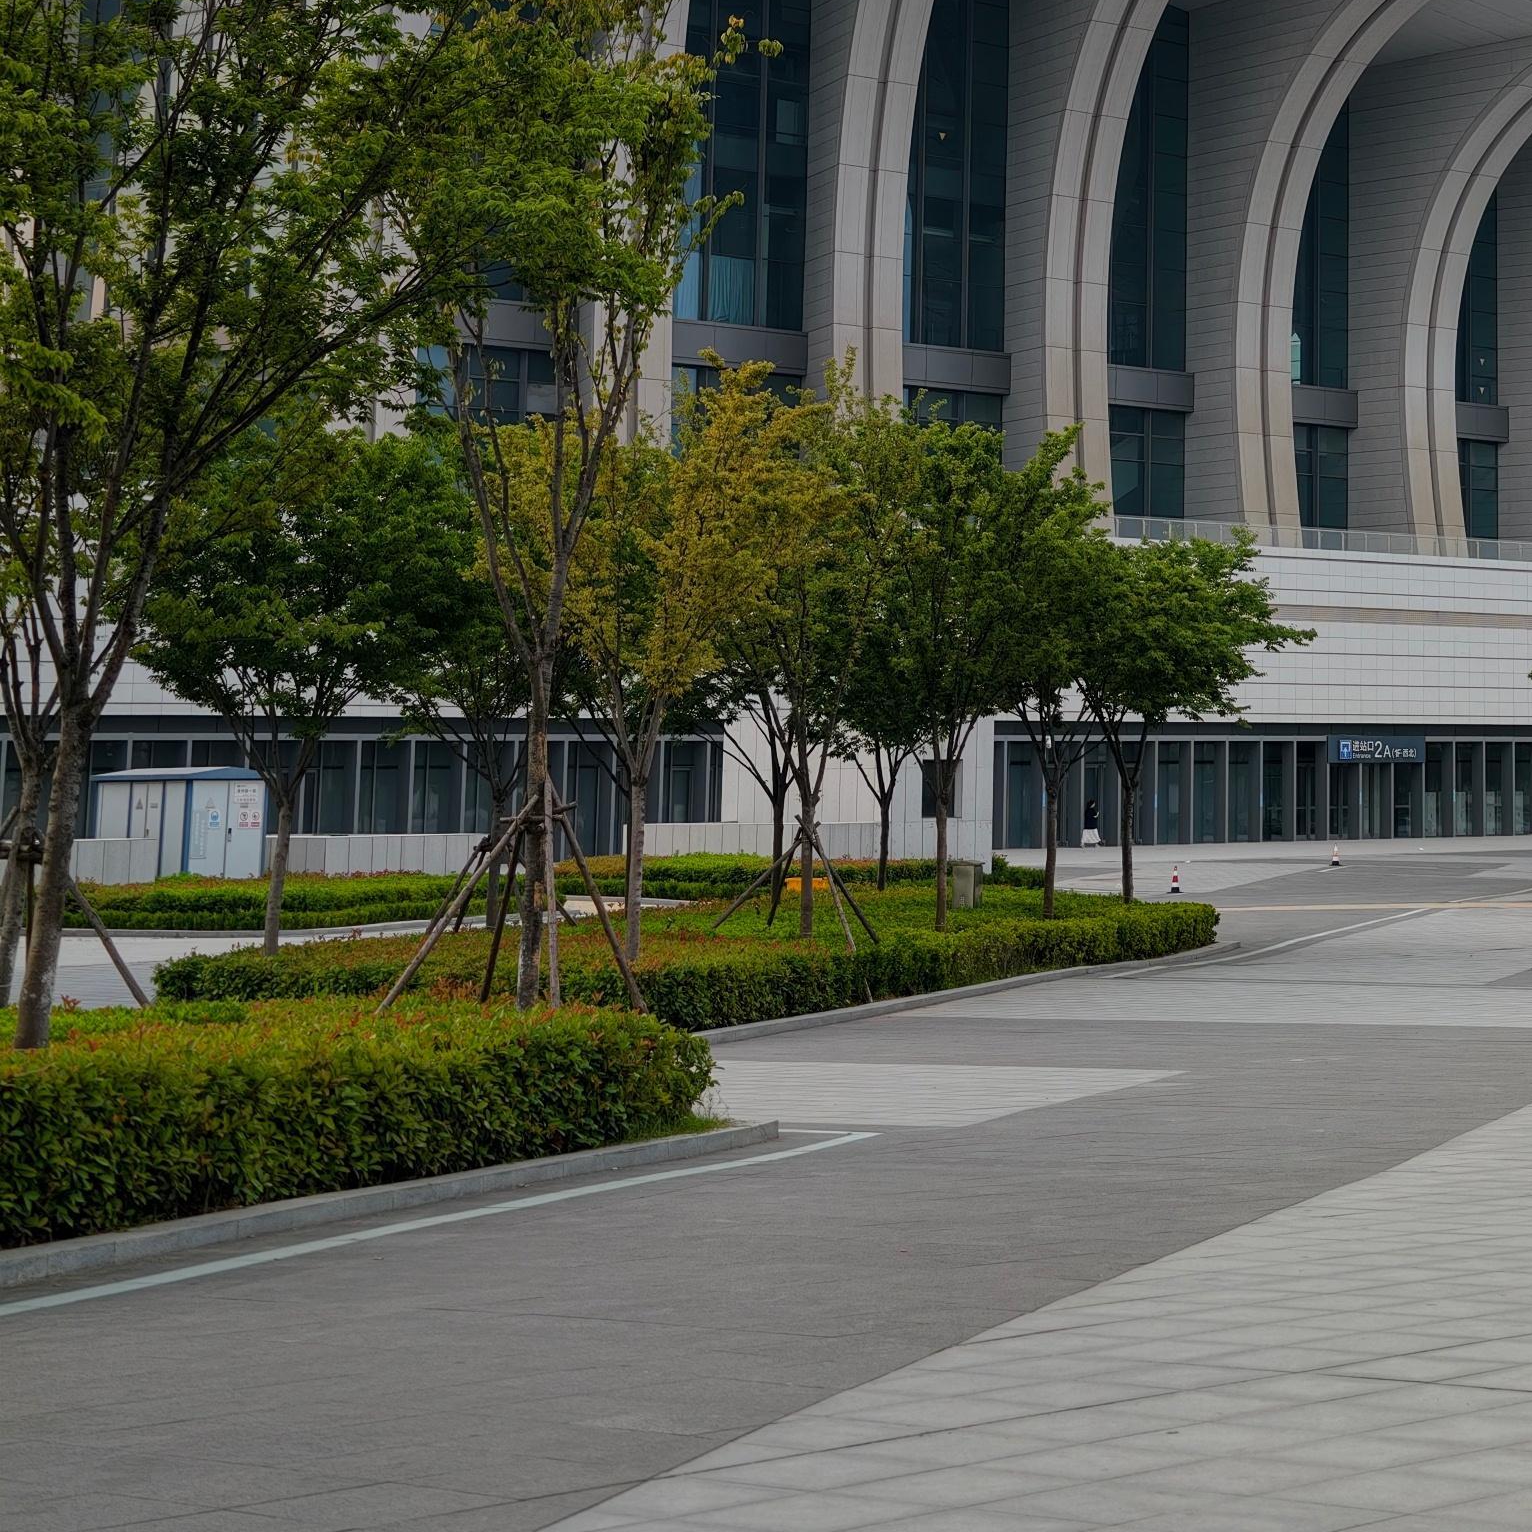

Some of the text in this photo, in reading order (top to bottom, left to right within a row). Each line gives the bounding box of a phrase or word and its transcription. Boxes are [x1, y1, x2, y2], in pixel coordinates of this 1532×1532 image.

[1352, 740, 1374, 752] 进站口
[1374, 740, 1392, 758] 2A
